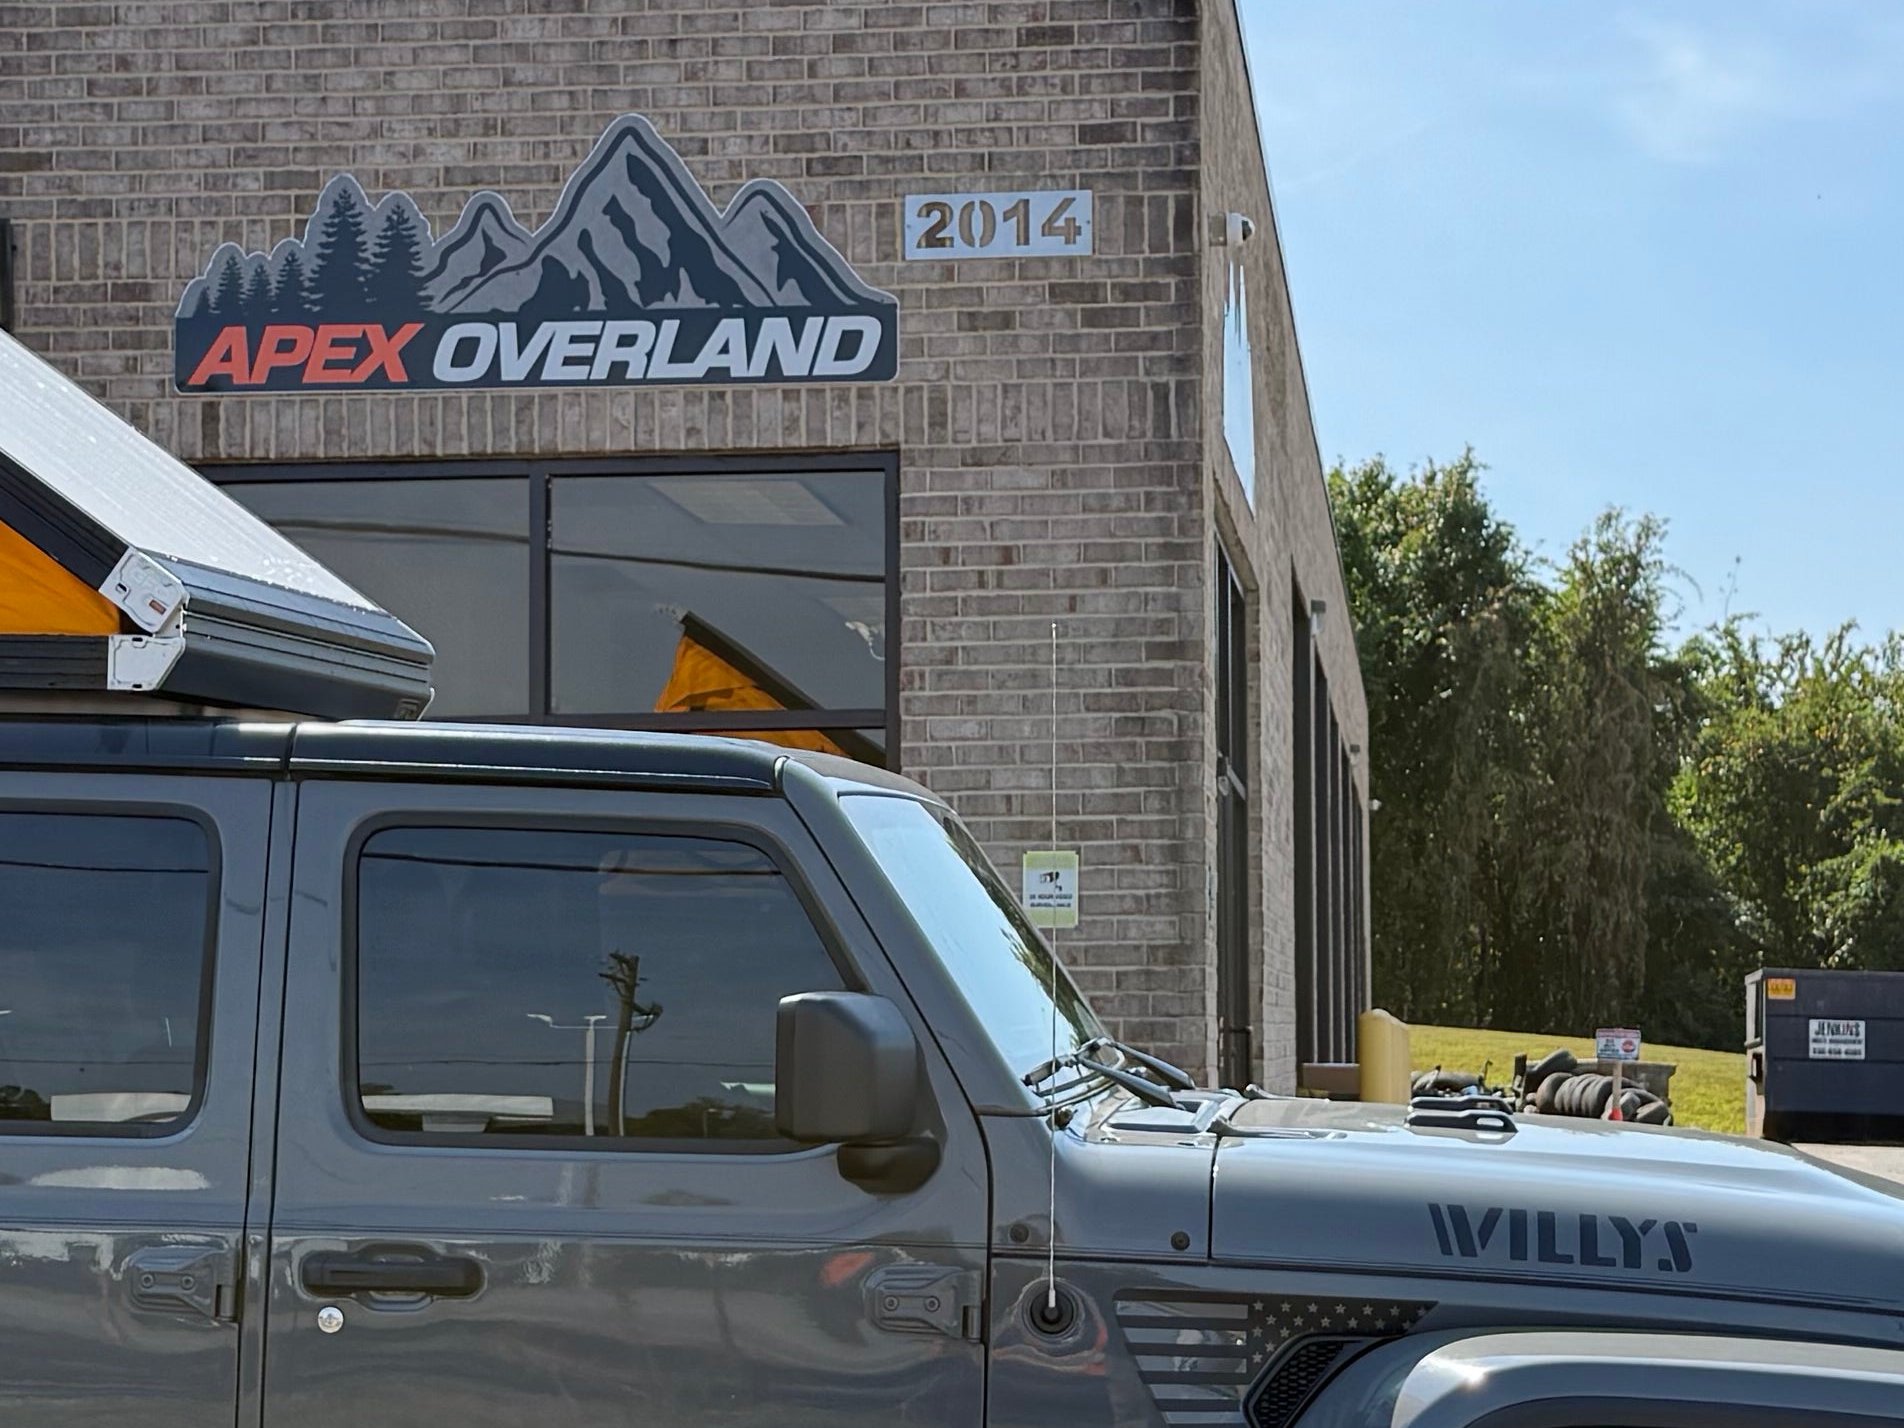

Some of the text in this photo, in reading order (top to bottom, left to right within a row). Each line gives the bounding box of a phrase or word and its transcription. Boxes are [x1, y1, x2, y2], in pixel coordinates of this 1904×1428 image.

[916, 197, 1082, 249] 2014
[187, 316, 882, 385] APEX OVERLAND
[1427, 1203, 1698, 1272] WILLYS
